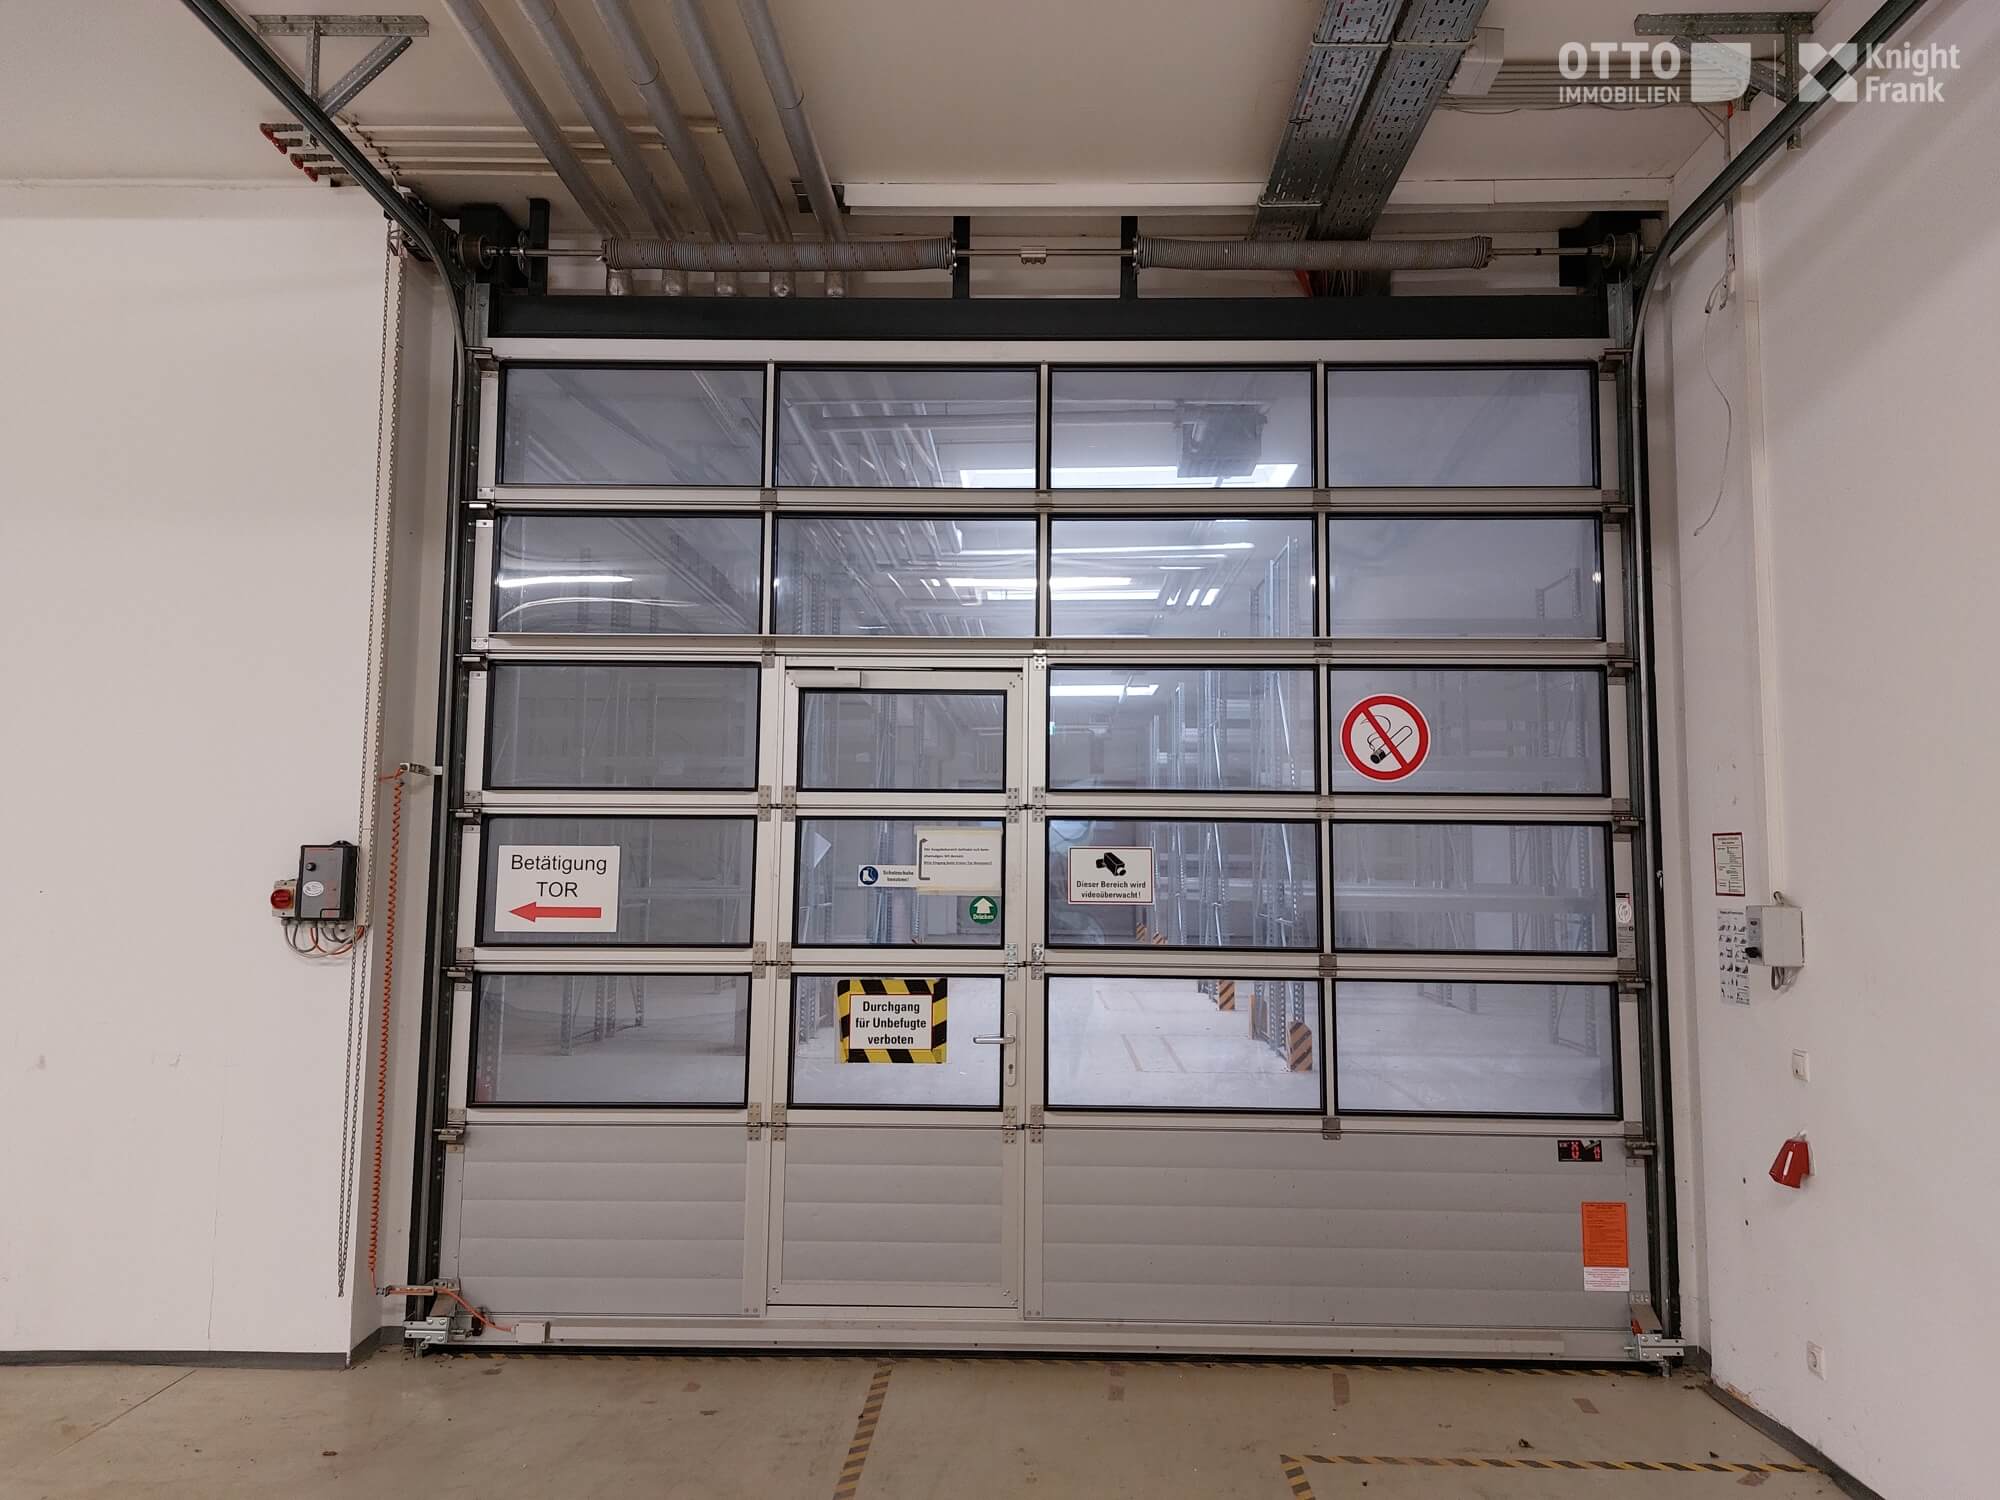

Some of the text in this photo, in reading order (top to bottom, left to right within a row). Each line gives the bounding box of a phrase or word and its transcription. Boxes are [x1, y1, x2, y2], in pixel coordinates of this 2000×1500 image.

[511, 854, 607, 875] Betätigung
[536, 881, 578, 897] TOR
[1076, 880, 1146, 889] Dieser Bereich wird
[863, 1001, 920, 1014] Durchgang
[855, 1017, 927, 1031] für Unbefugte
[868, 1033, 914, 1045] verboten
